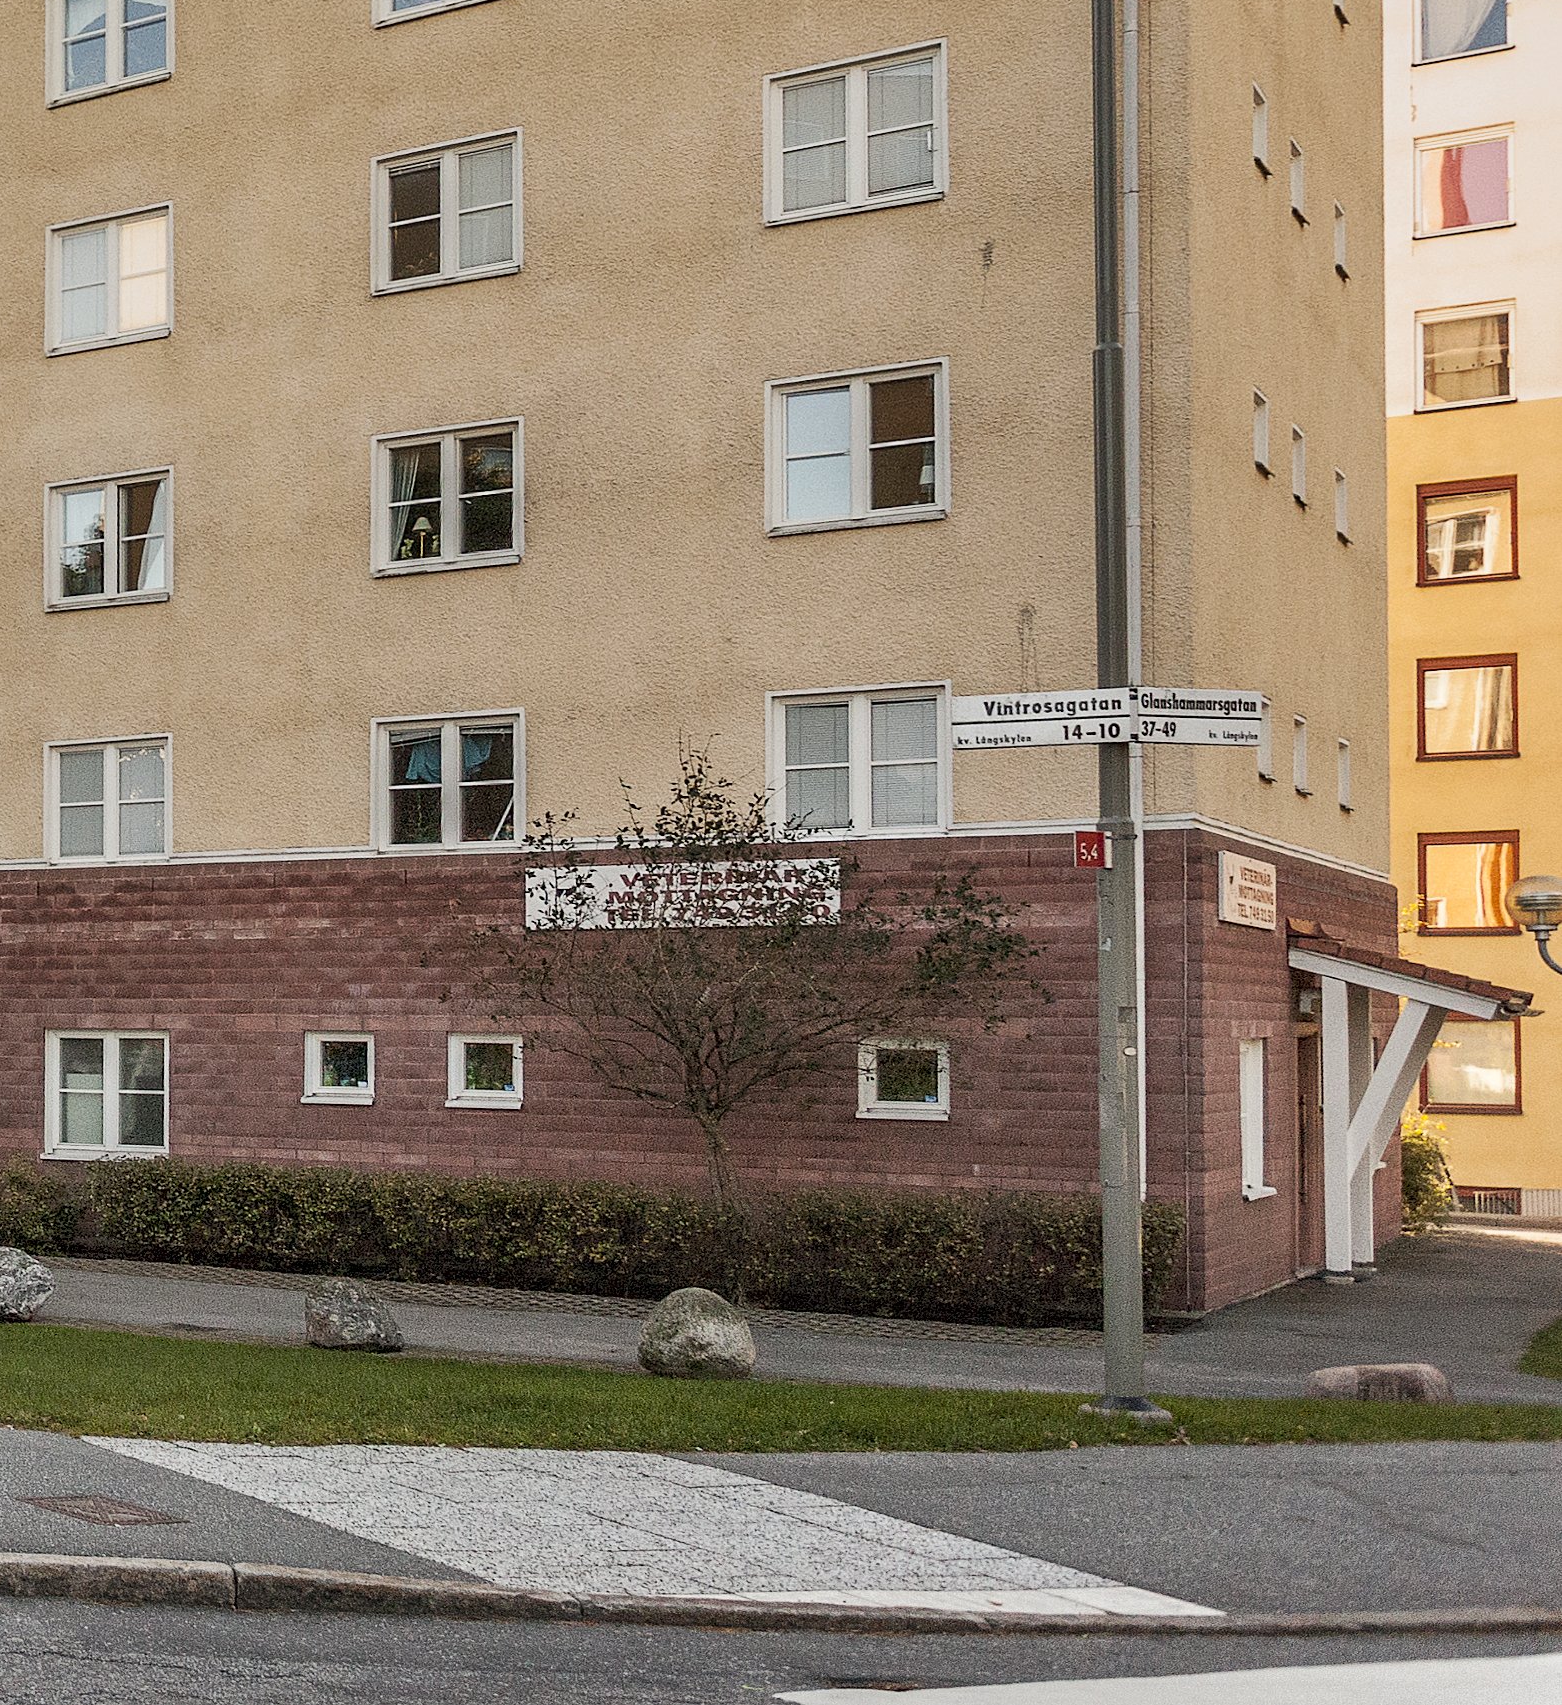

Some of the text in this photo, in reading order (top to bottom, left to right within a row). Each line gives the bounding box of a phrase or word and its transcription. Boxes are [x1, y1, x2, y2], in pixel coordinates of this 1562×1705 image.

[983, 697, 1122, 717] Vintrosagatan
[1141, 692, 1257, 715] Glanshammarsgatan
[1141, 720, 1177, 737] 37-49
[957, 736, 973, 746] kv.
[1080, 842, 1098, 862] 5,4
